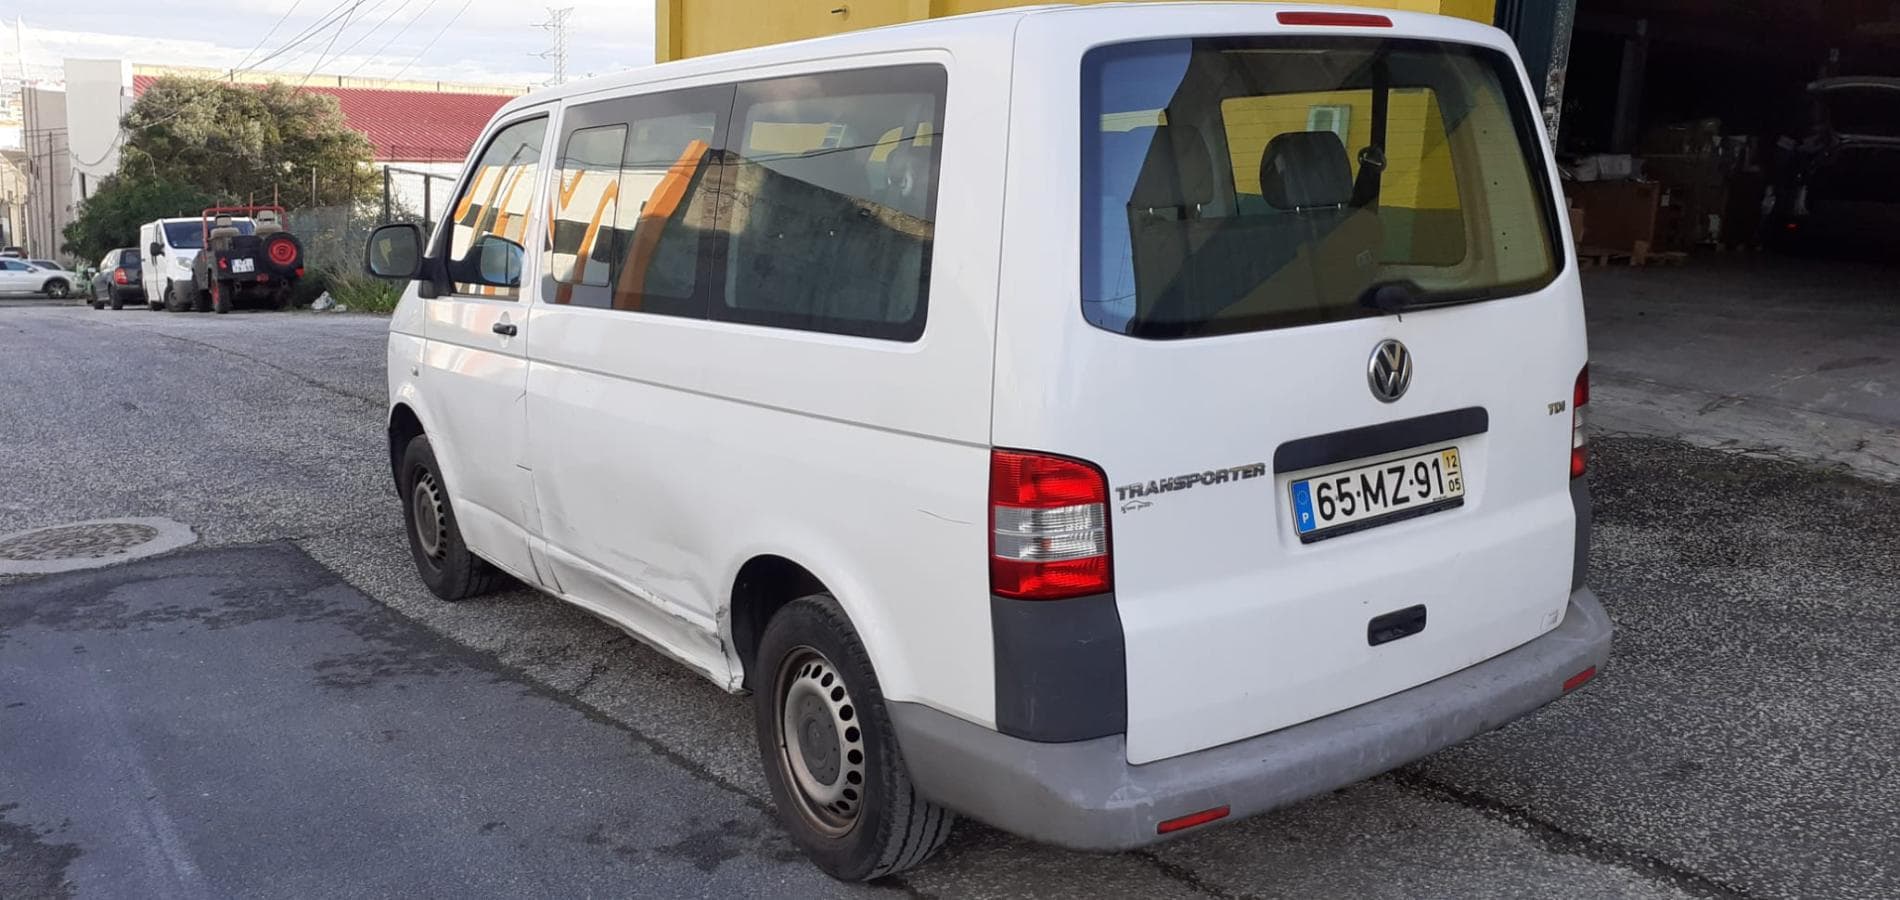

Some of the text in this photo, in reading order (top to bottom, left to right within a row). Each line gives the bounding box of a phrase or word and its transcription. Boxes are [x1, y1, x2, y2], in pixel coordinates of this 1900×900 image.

[1547, 400, 1566, 416] TDI
[1446, 455, 1458, 469] 12
[1115, 462, 1266, 501] TRANSPORTER
[1448, 478, 1462, 493] 05
[1302, 512, 1310, 524] P
